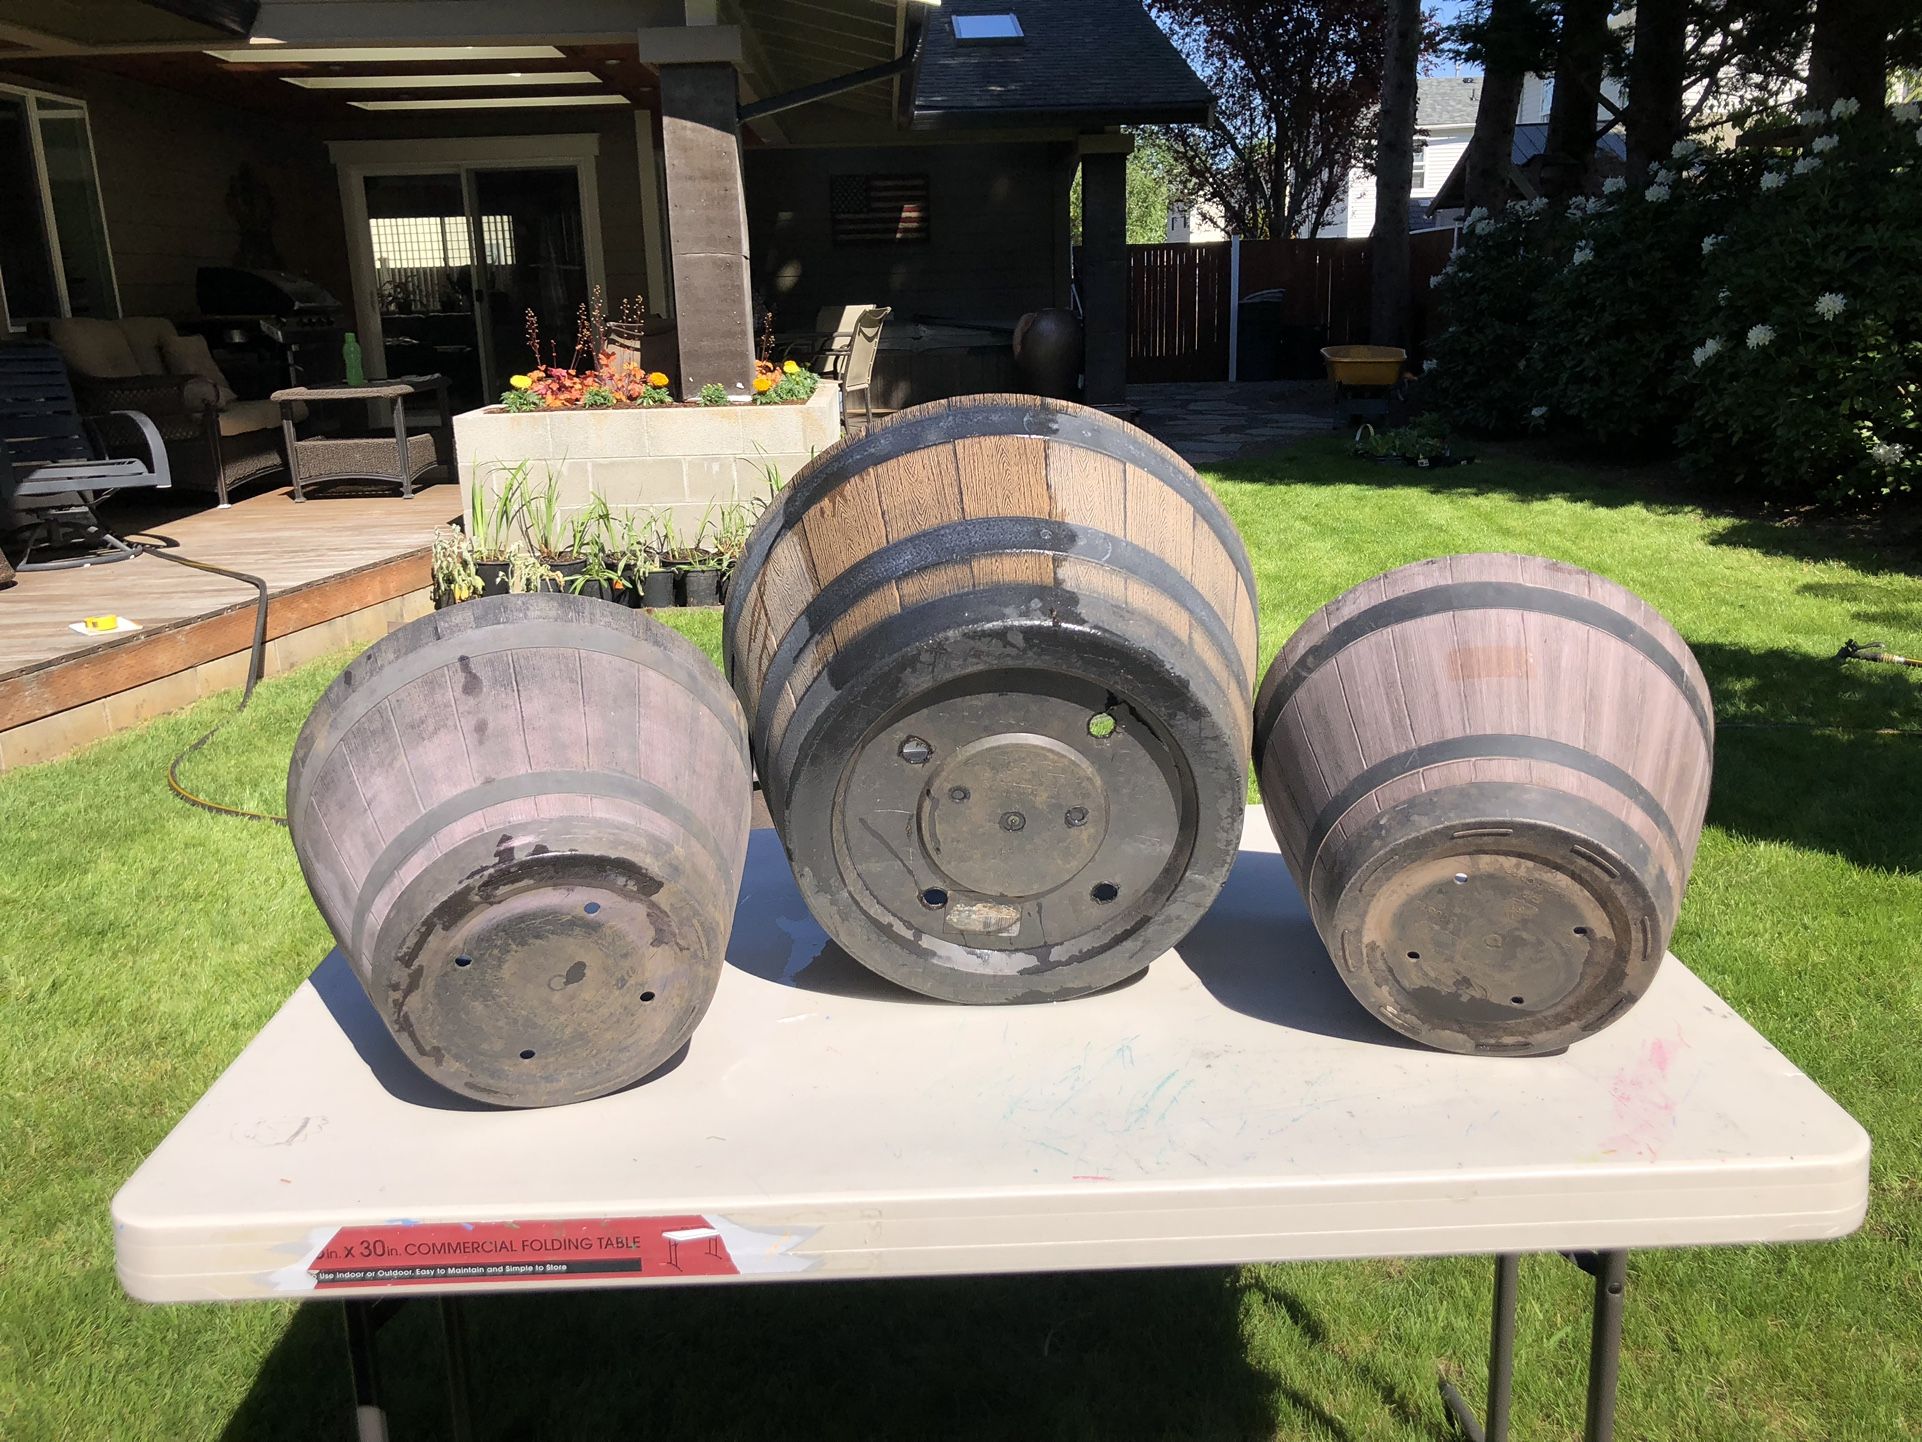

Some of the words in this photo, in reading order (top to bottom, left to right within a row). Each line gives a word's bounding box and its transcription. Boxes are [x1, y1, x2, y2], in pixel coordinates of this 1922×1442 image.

[344, 1246, 355, 1259] x
[404, 1240, 517, 1256] COMMERCIAL
[521, 1237, 593, 1251] FOLDING
[597, 1236, 641, 1249] TABLE
[336, 1271, 364, 1279] Indoor
[416, 1267, 434, 1277] Easy
[448, 1265, 485, 1274] Maintain
[487, 1265, 503, 1273] and
[505, 1264, 533, 1273] Simple
[545, 1263, 567, 1271] Store
